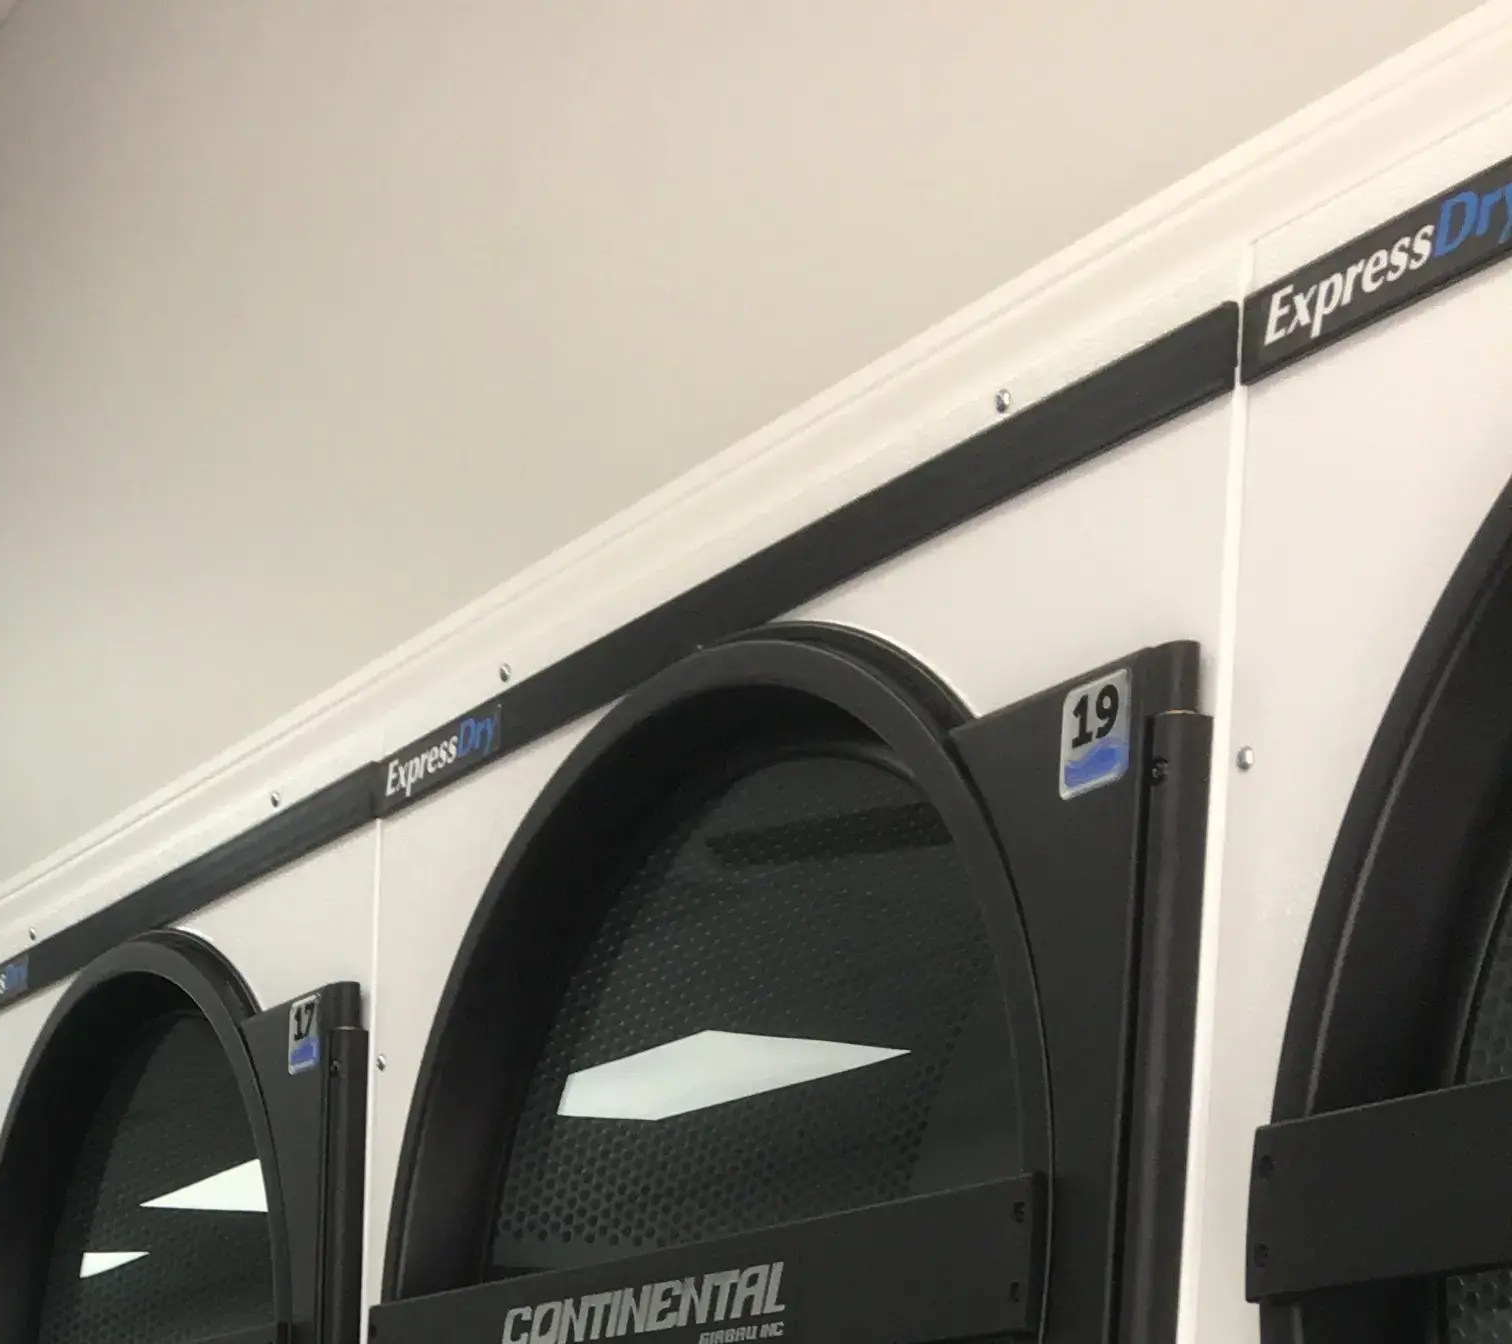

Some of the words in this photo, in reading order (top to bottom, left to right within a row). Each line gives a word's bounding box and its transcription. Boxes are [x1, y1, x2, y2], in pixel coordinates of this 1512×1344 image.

[1071, 683, 1119, 748] 19
[385, 716, 497, 797] ExpressDry
[294, 1002, 315, 1042] 17
[759, 1321, 784, 1339] INC
